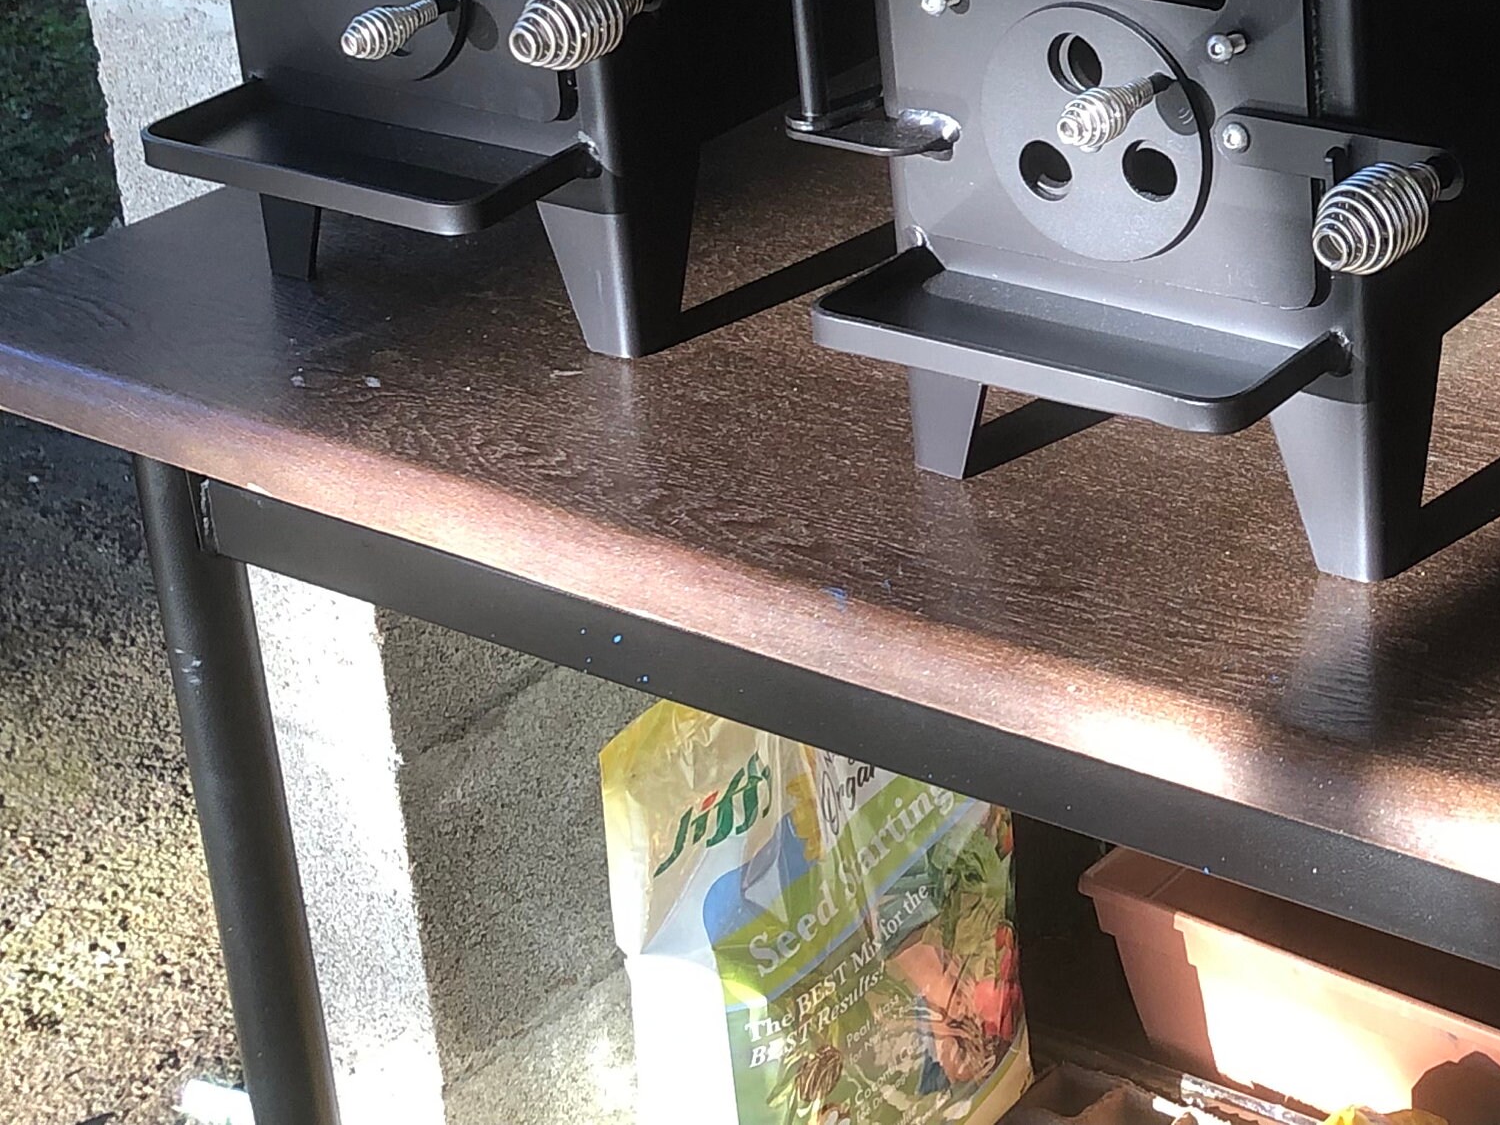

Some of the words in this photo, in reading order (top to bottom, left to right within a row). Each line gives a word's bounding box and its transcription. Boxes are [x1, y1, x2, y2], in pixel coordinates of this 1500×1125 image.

[821, 765, 875, 835] Orga
[744, 1012, 794, 1043] The
[796, 961, 847, 1021] BEST
[850, 940, 883, 972] Mix
[877, 910, 903, 941] for
[902, 884, 929, 915] the
[749, 879, 839, 977] Seed
[749, 1020, 813, 1068] BEST
[817, 960, 886, 1034] Results!
